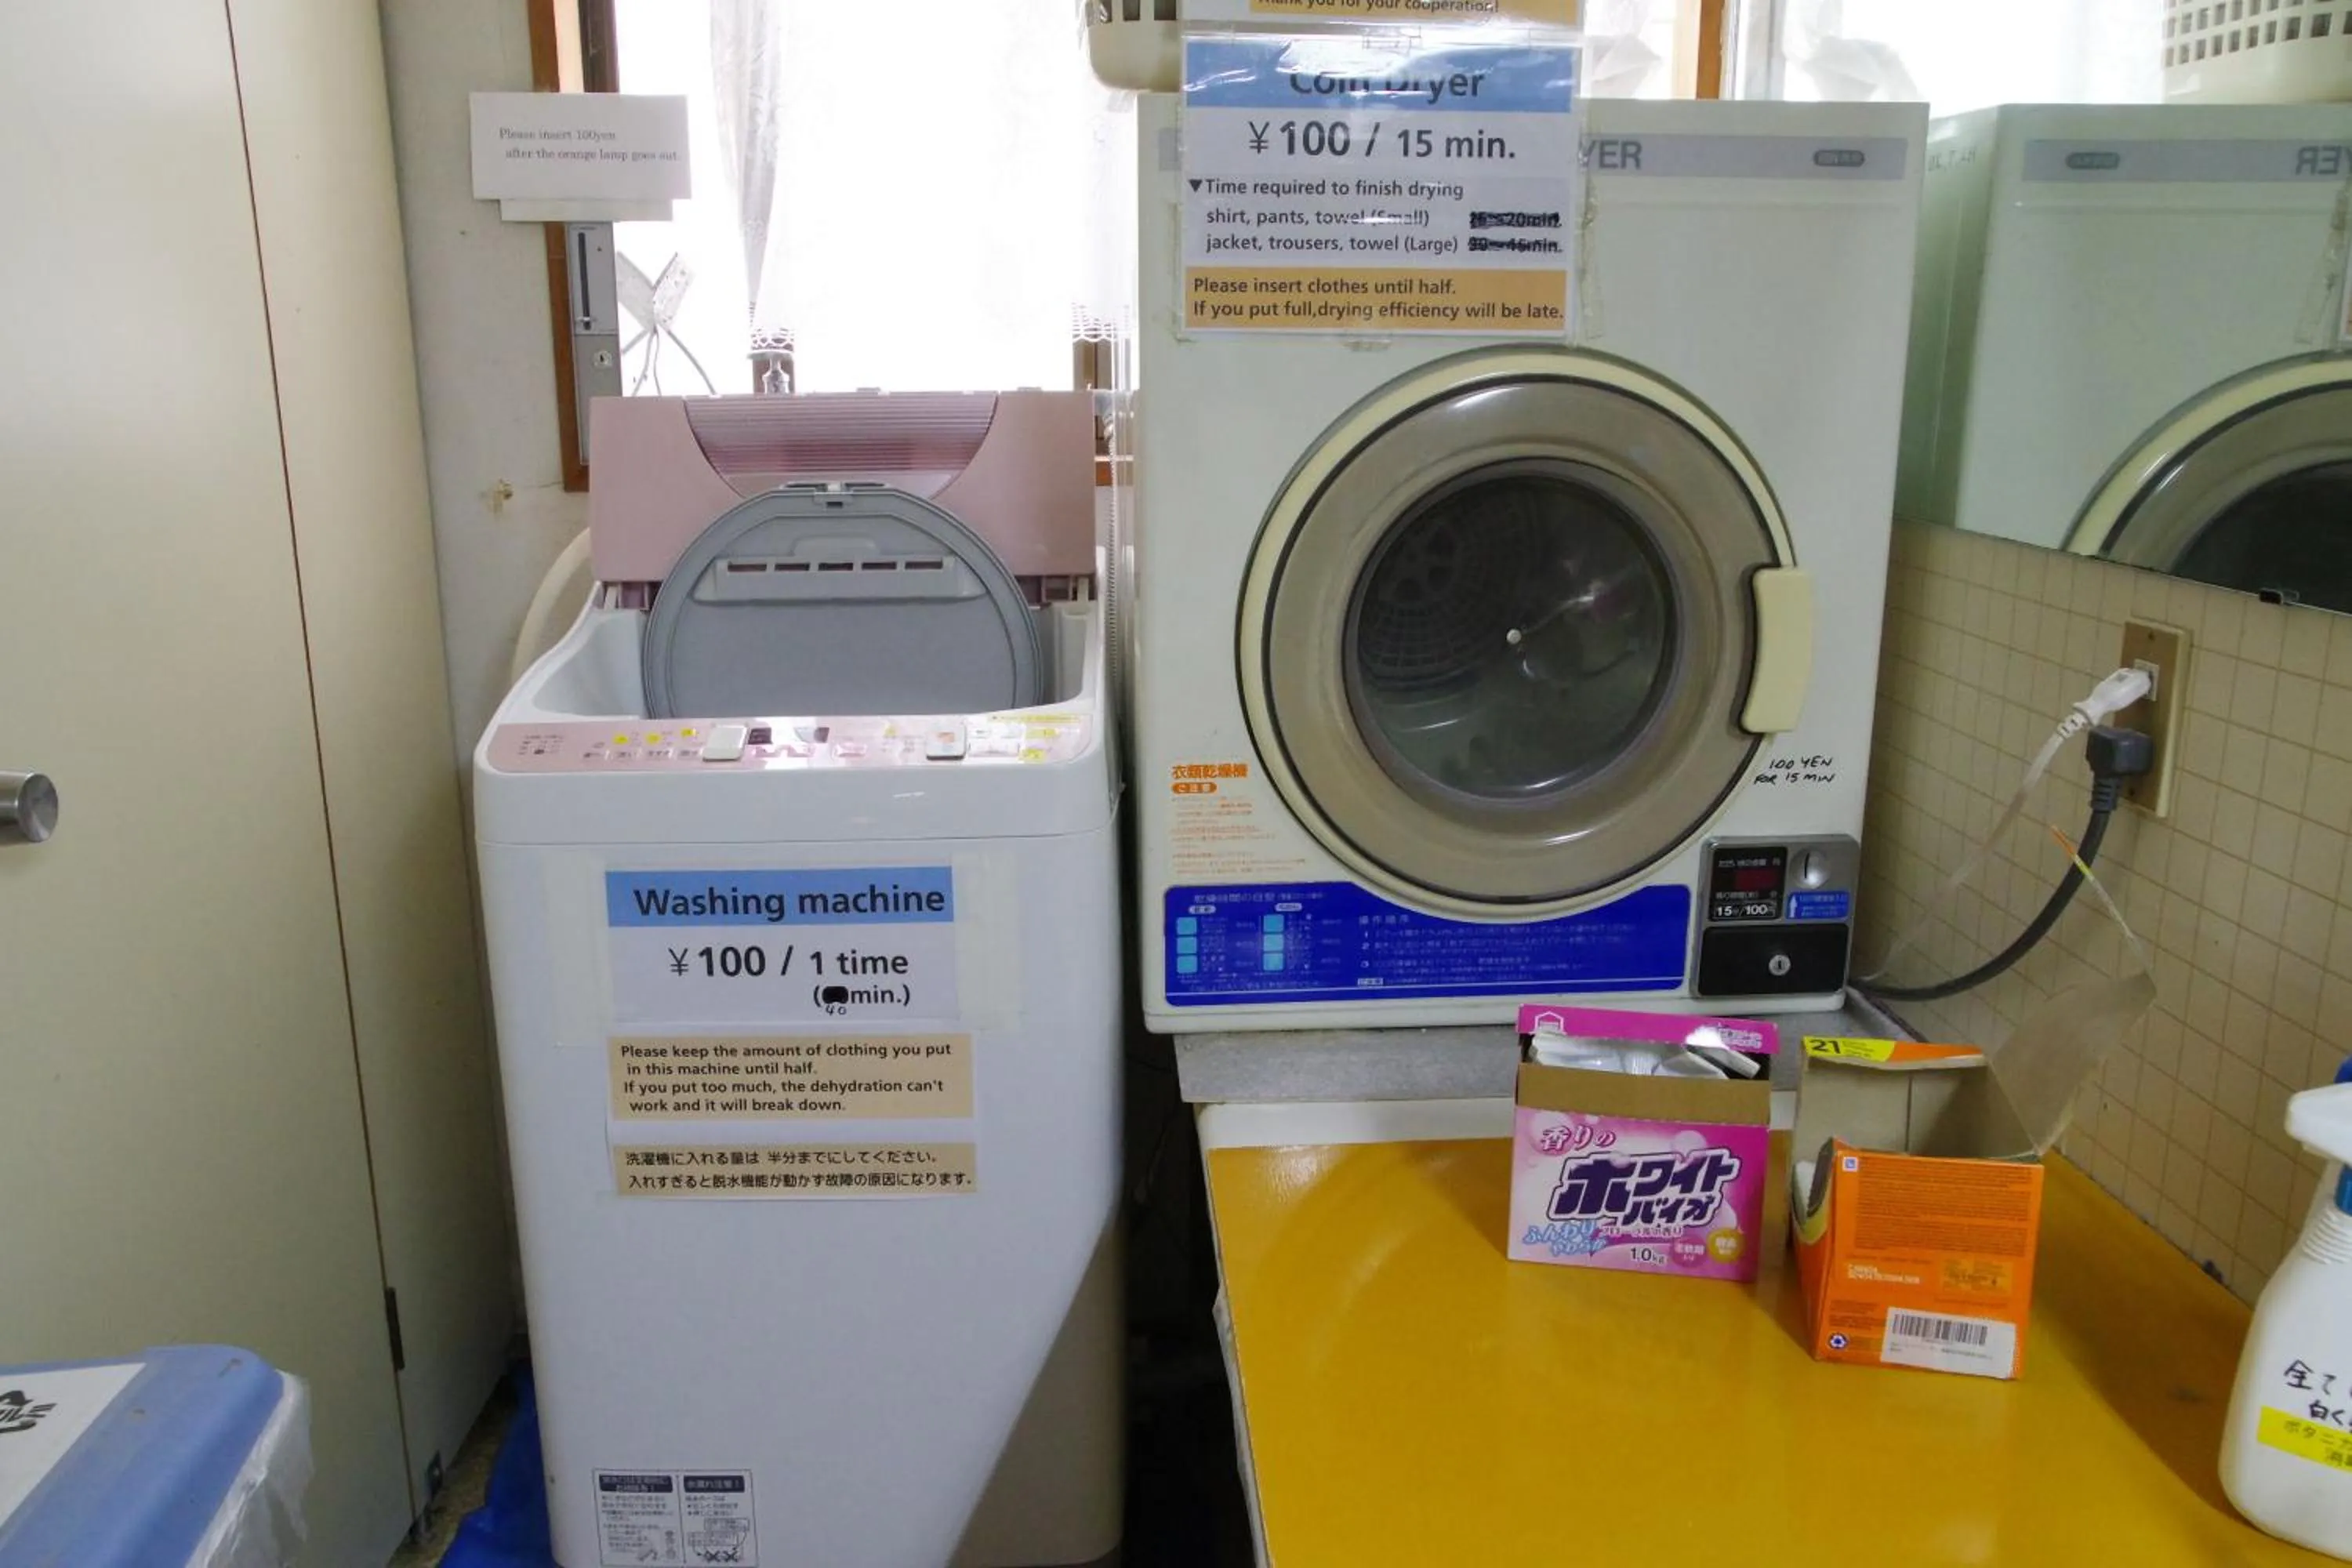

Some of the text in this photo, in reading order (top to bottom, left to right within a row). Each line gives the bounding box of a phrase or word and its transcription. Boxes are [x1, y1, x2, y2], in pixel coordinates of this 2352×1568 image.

[1365, 122, 1381, 157] /
[1398, 129, 1432, 158] 15
[1445, 129, 1515, 158] min.
[1206, 179, 1465, 201] Time required to finish drying
[1206, 208, 1251, 225] shirt,
[1256, 209, 1309, 227] pants,
[1316, 209, 1366, 225] towel
[1206, 234, 1263, 253] jacket,
[1269, 235, 1344, 252] trousers,
[1349, 236, 1399, 252] towel
[1403, 236, 1459, 256] (Large)
[1193, 278, 1457, 295] Please insert clothes until half.
[1193, 300, 1207, 317] If
[1211, 303, 1244, 320] you
[1249, 302, 1280, 320] put
[1378, 301, 1461, 321] efficiency
[1465, 303, 1496, 318] will
[1501, 303, 1523, 319] be
[1527, 303, 1565, 320] late.
[1769, 754, 1834, 770] 100 YEN
[1753, 771, 1836, 786] FOR 15 MIN
[633, 884, 946, 923] Washing machine
[780, 945, 794, 977] /
[810, 952, 823, 975] 1
[837, 949, 909, 975] time
[826, 1004, 848, 1016] 40
[621, 1041, 952, 1059] Please keep the amount of clothing you put
[1809, 1039, 1841, 1054] 21
[626, 1062, 818, 1075] in this machine until half.
[624, 1079, 945, 1096] If you put too much, the dehydration can't
[630, 1098, 846, 1112] work and it will break down.
[1540, 1124, 1617, 1152] 香りの
[1553, 1153, 1735, 1214] ホワイト
[1621, 1195, 1716, 1226] バイオ
